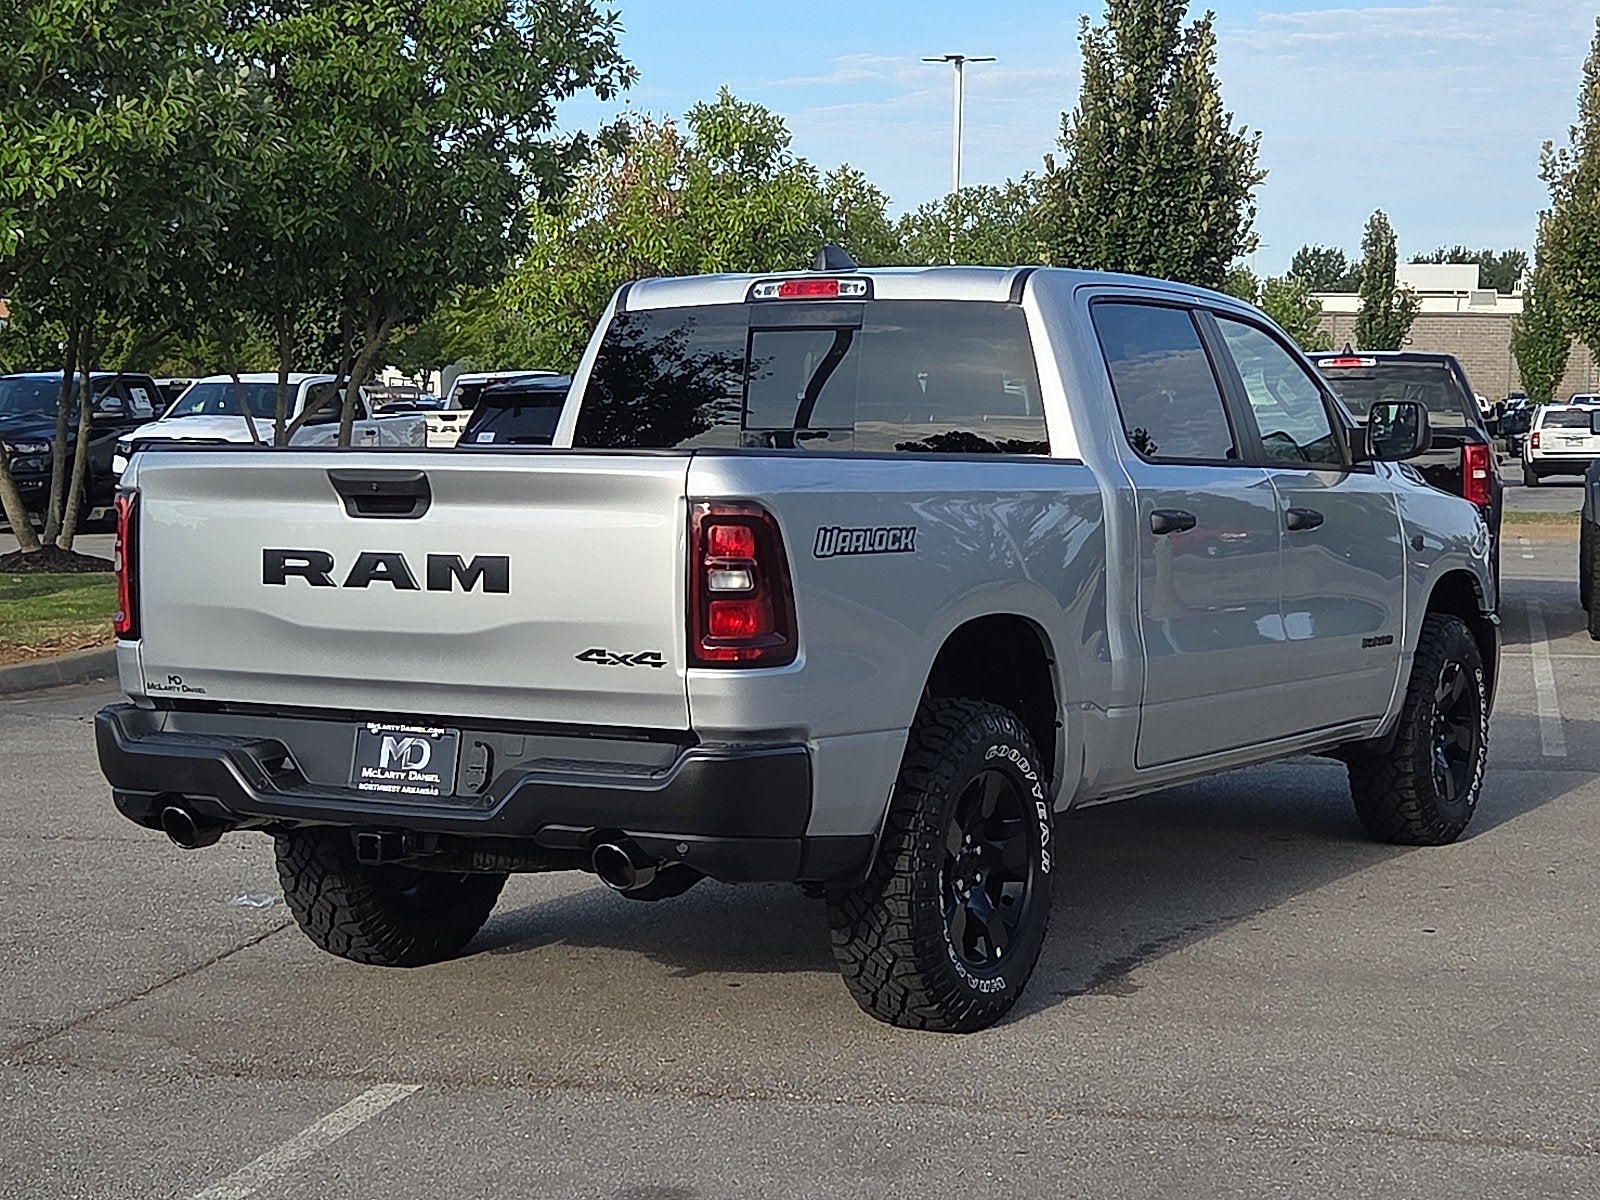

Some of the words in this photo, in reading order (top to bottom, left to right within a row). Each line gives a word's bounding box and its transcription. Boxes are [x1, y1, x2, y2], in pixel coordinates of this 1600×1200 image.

[814, 527, 917, 558] WARLOCK
[263, 548, 510, 594] RAM
[380, 736, 431, 770] MD
[408, 771, 440, 782] DANIEL
[985, 745, 1050, 873] GOODYEAR
